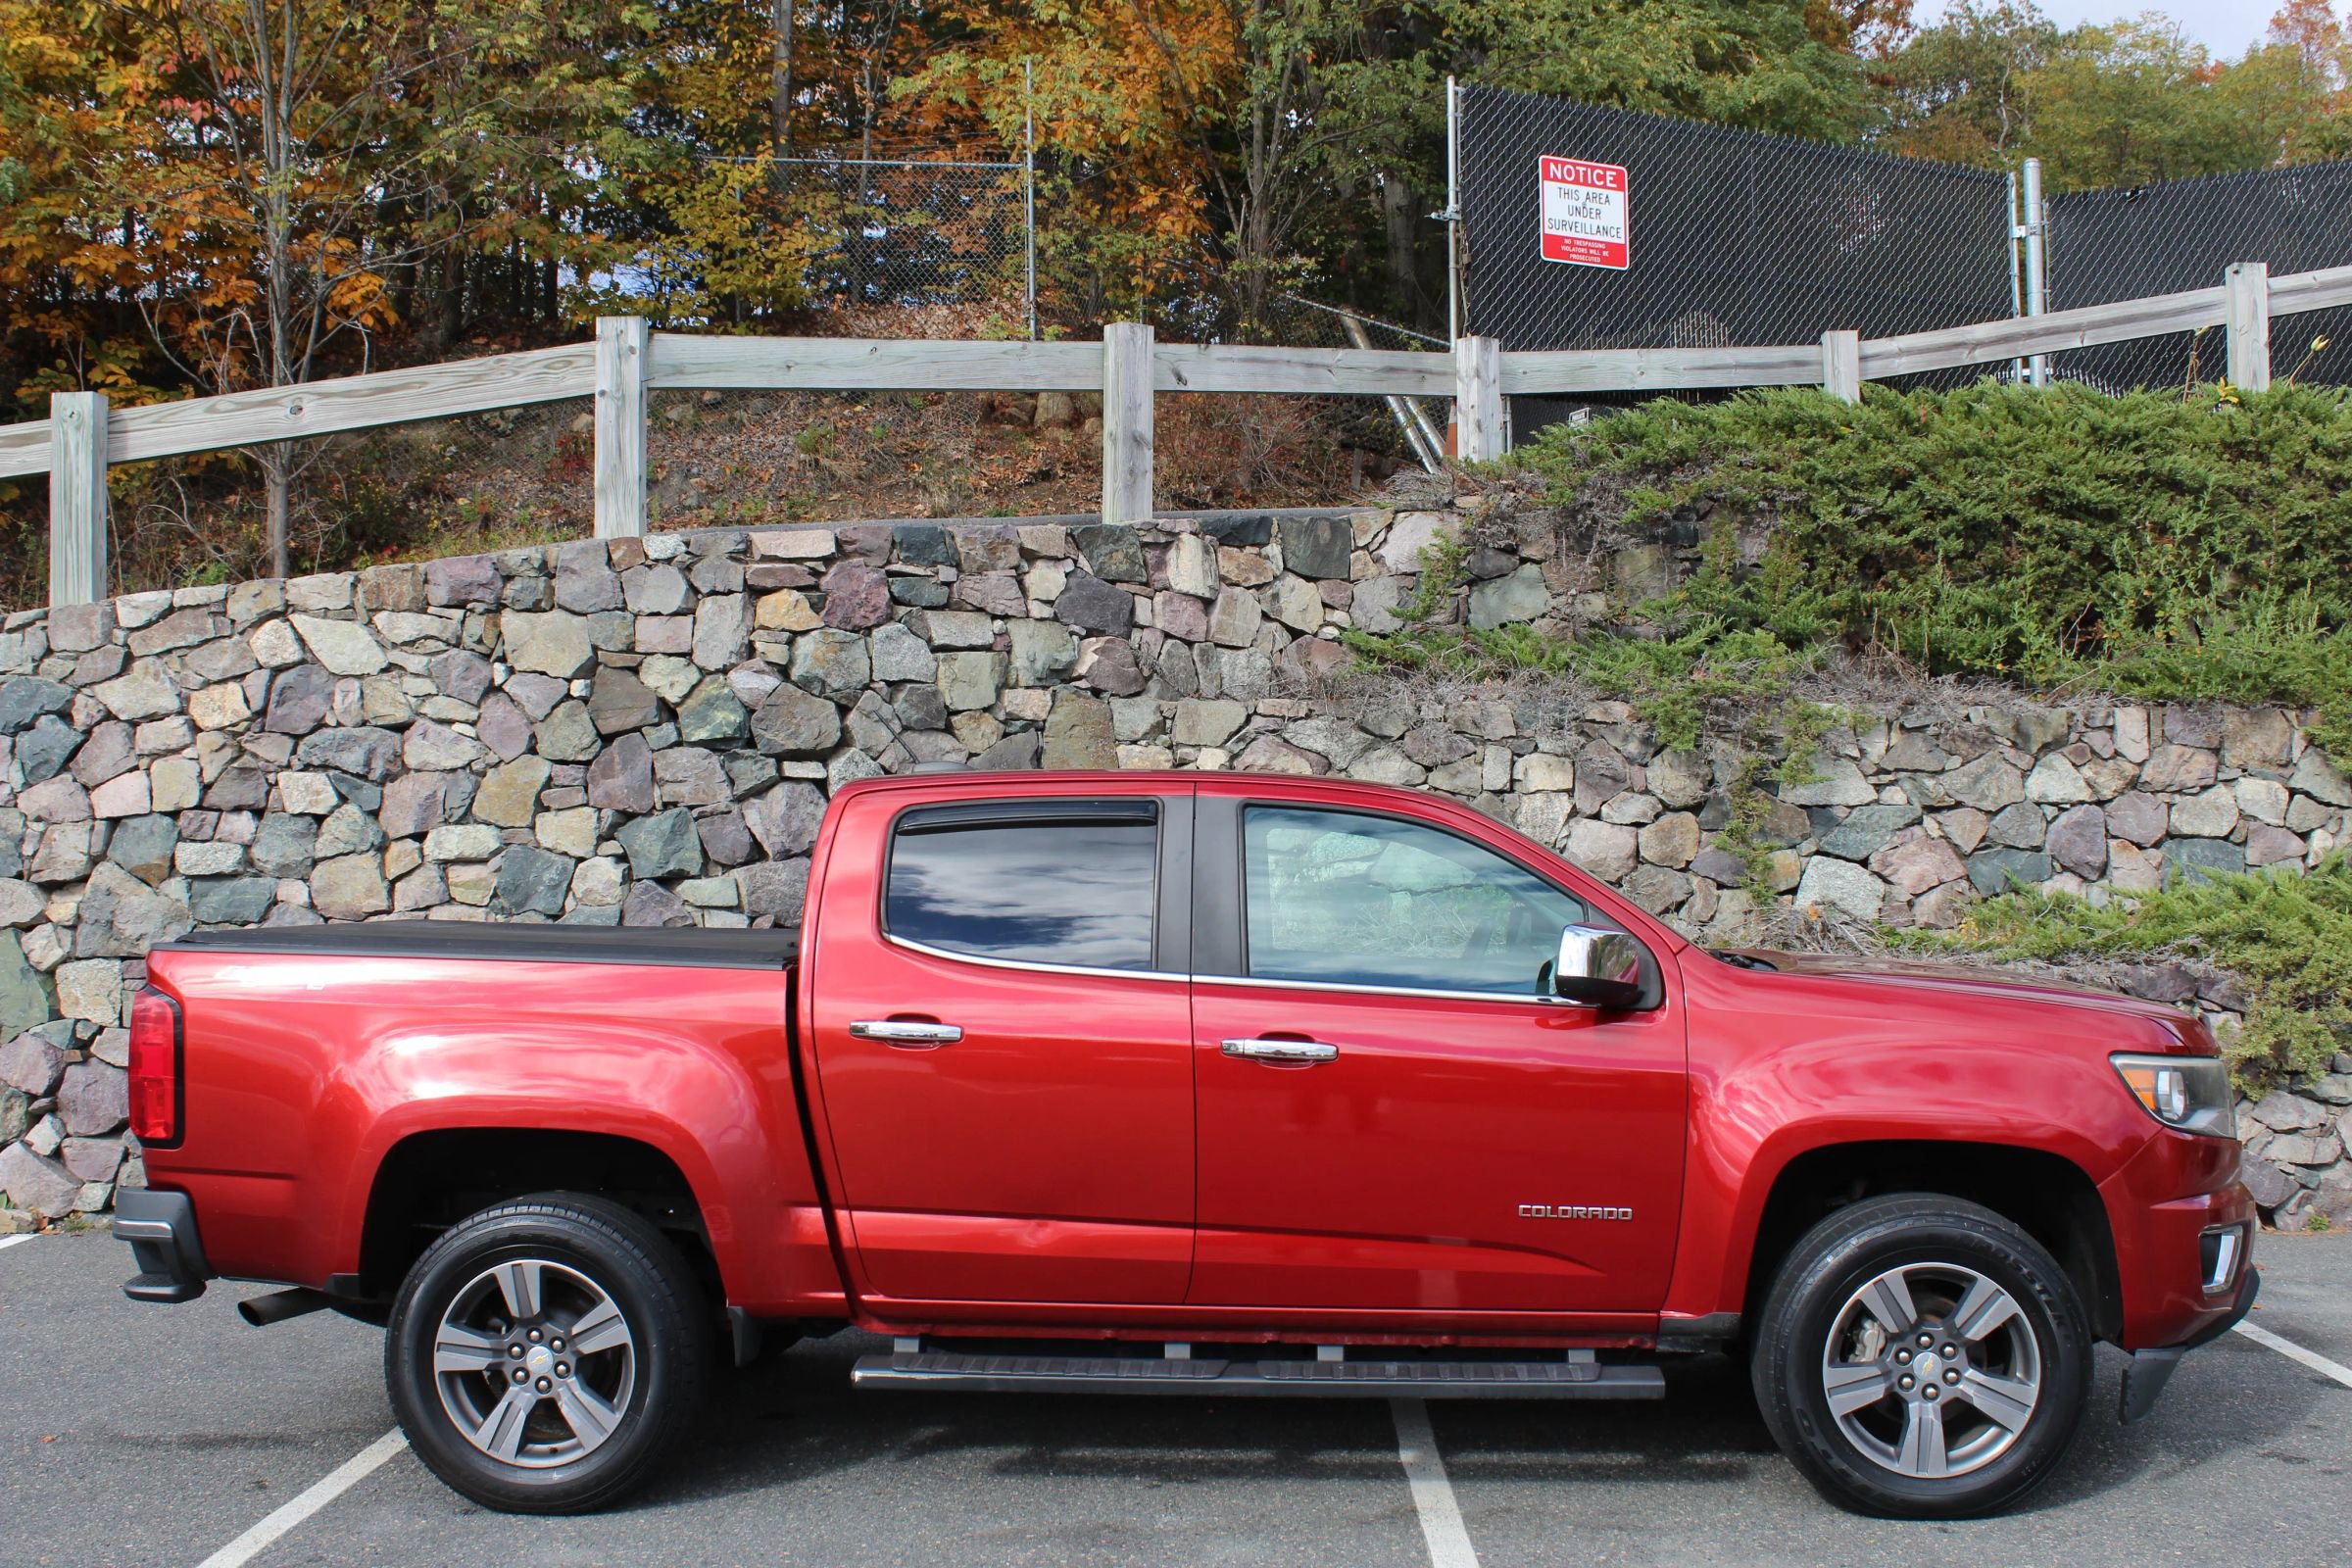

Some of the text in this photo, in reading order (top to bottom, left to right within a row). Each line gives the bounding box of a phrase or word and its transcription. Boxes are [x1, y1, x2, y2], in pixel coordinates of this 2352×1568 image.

[1549, 162, 1617, 188] NOTICE
[1557, 186, 1611, 206] THIS AREA
[1568, 205, 1601, 220] UNDER
[1547, 218, 1622, 239] SURVEILLANCE
[1561, 245, 1588, 254] VIOLATORS
[1574, 239, 1606, 249] TRESPASSING
[1569, 253, 1601, 263] PROSECUTED
[1518, 1204, 1633, 1220] COLORADO
